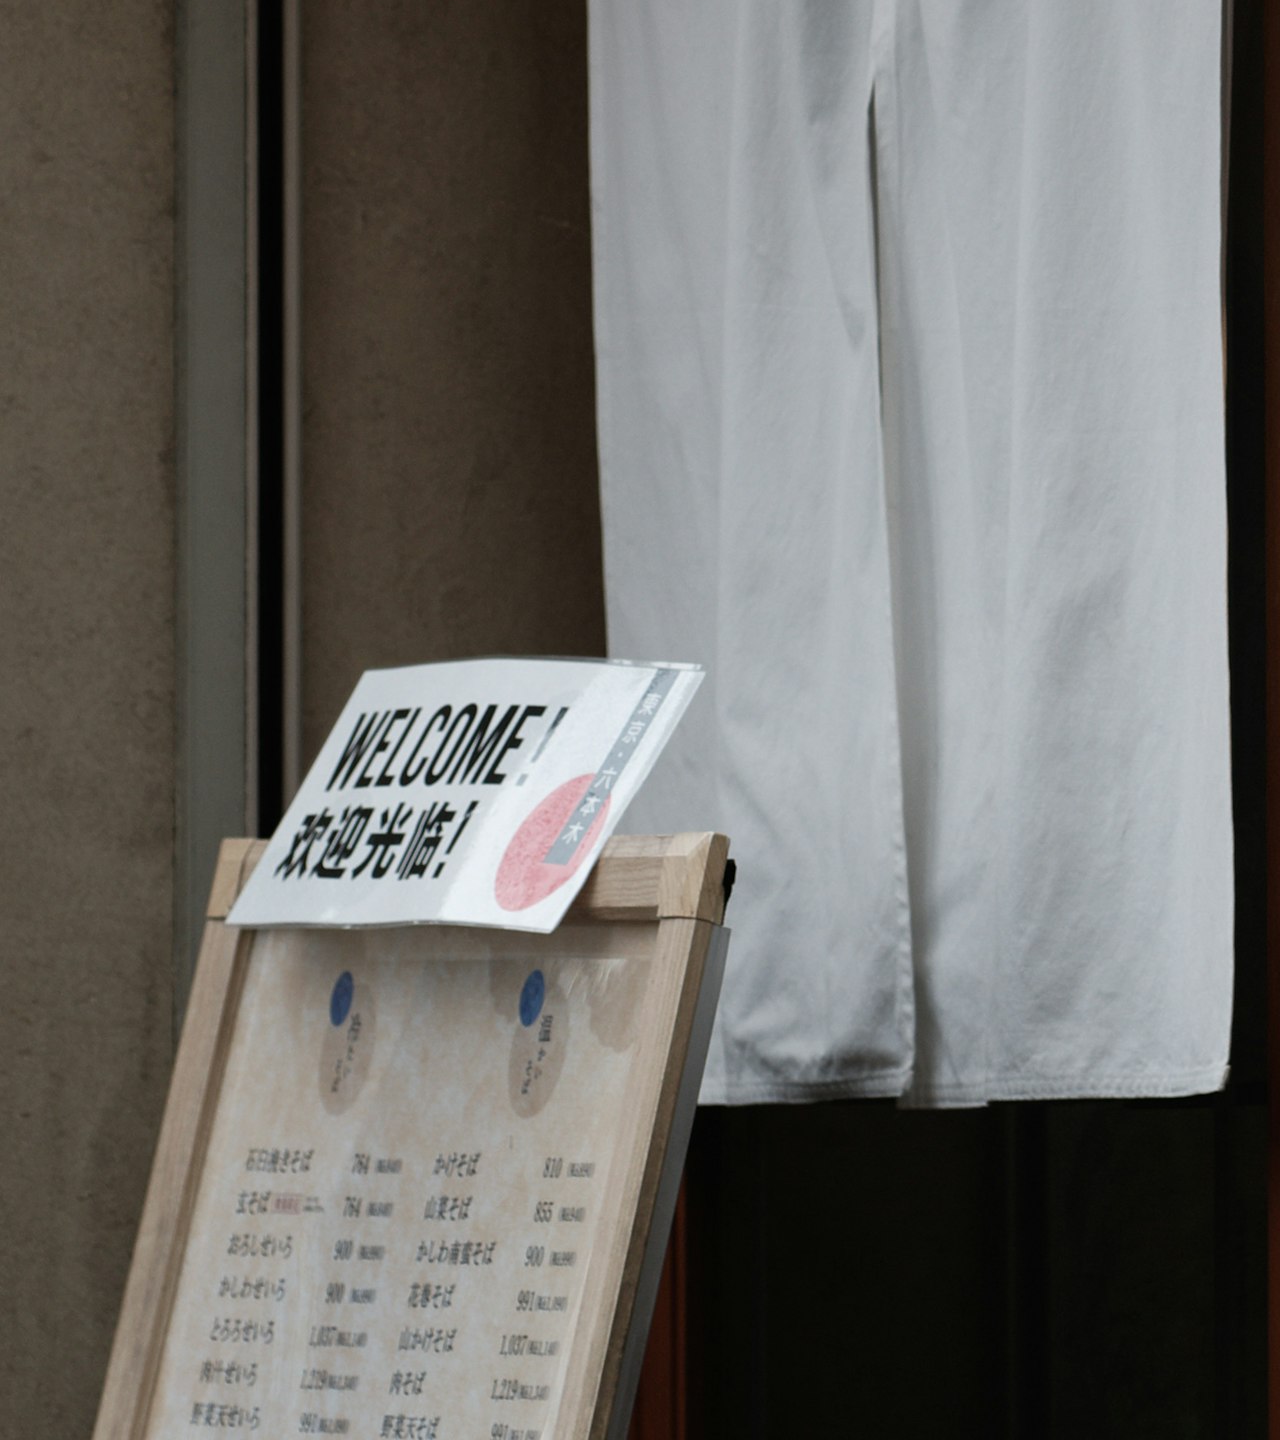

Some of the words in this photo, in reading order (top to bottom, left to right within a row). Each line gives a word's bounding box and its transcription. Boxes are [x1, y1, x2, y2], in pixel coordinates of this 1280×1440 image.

[433, 1152, 481, 1177] かけそば
[542, 1157, 562, 1177] 810
[534, 1201, 554, 1222] 855
[524, 1246, 545, 1266] 900
[516, 1290, 535, 1311] 991
